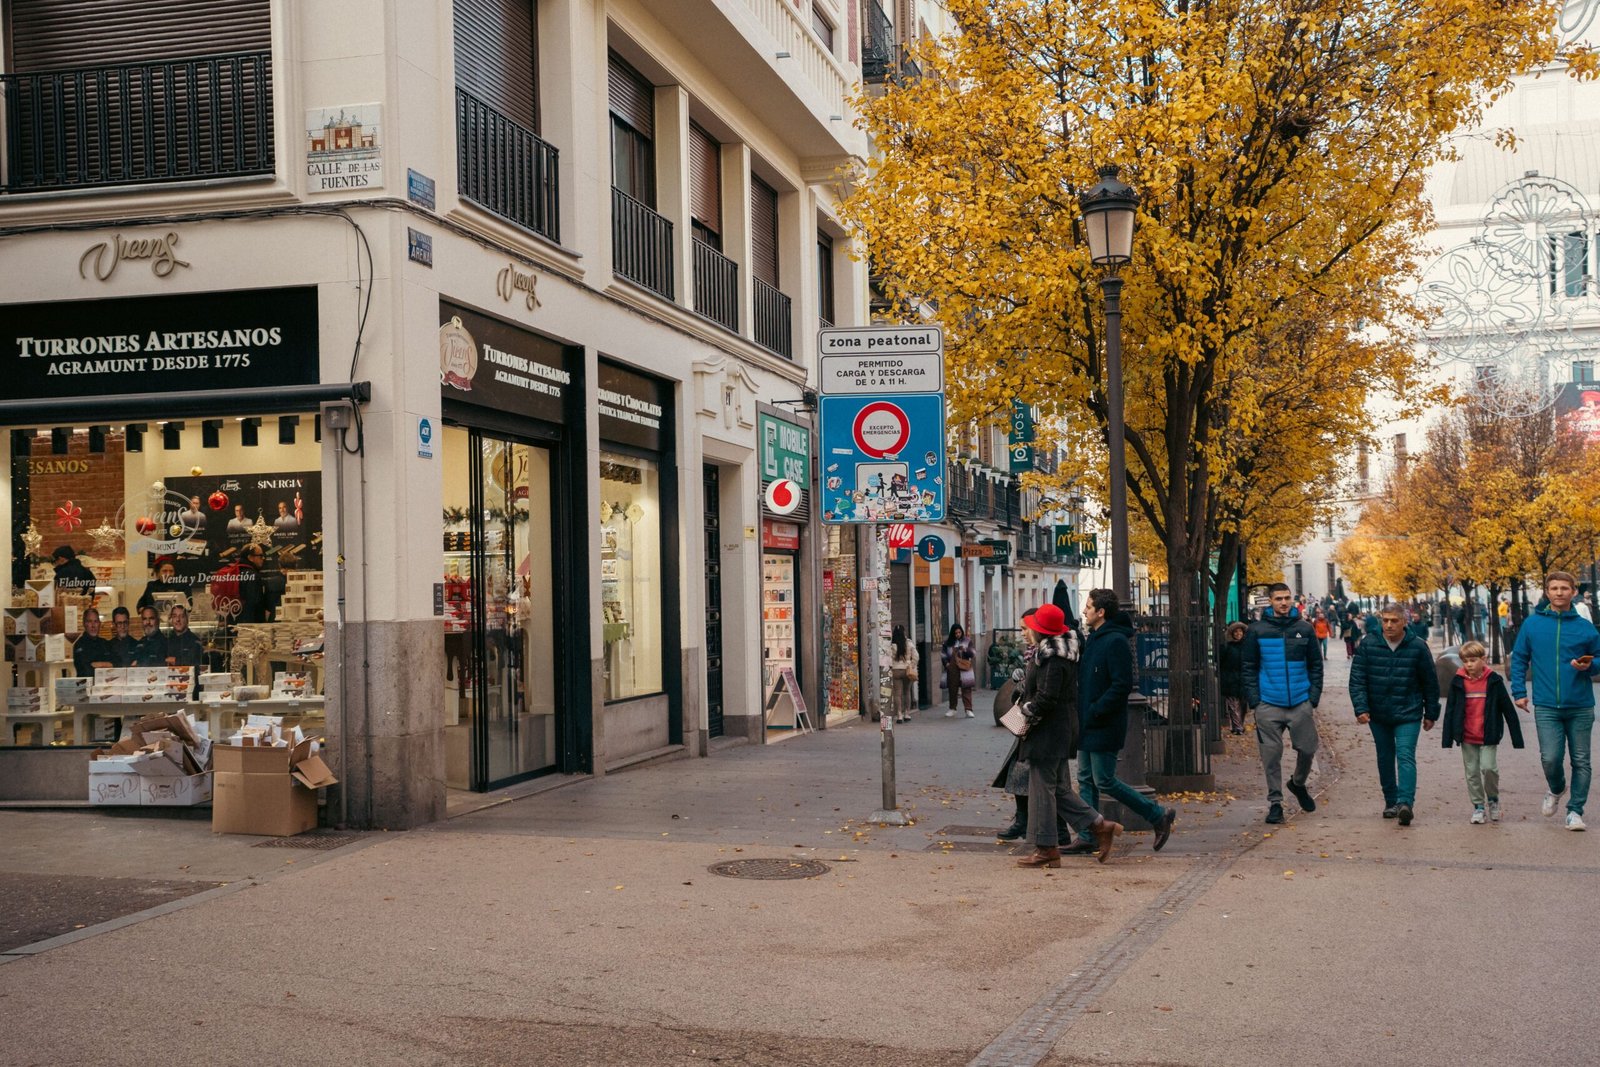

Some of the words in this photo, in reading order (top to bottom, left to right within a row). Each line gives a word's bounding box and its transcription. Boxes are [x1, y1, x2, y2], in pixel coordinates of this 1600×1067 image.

[307, 162, 342, 176] CALLE
[348, 163, 359, 173] DE
[364, 162, 380, 172] LAS
[321, 175, 368, 189] FUENTES
[79, 232, 191, 281] Vicens
[16, 334, 140, 358] TURRONES
[144, 327, 282, 352] ARTESANOS
[829, 338, 861, 347] zona
[868, 334, 931, 349] peatonal
[47, 358, 148, 376] AGRAMUNT
[152, 355, 209, 371] DESDE
[214, 353, 251, 368] 1775
[483, 343, 528, 373] TURRONES
[528, 360, 571, 385] ARTESANOS
[858, 360, 904, 368] PERMITIDO
[878, 368, 926, 376] DESCARGA
[494, 370, 530, 388] AGRAMUNT
[530, 379, 549, 394] DESDE
[549, 385, 561, 398] 1775
[621, 394, 626, 406] Y
[625, 395, 662, 417] CHOCOLATES
[1014, 396, 1024, 440] HOSTA
[780, 425, 807, 456] MOBILE
[29, 460, 89, 474] ESANOS
[784, 456, 804, 483] CASE
[257, 479, 303, 489] SINERGIA
[889, 524, 913, 545] illy
[161, 574, 188, 584] Venta
[189, 577, 196, 586] y
